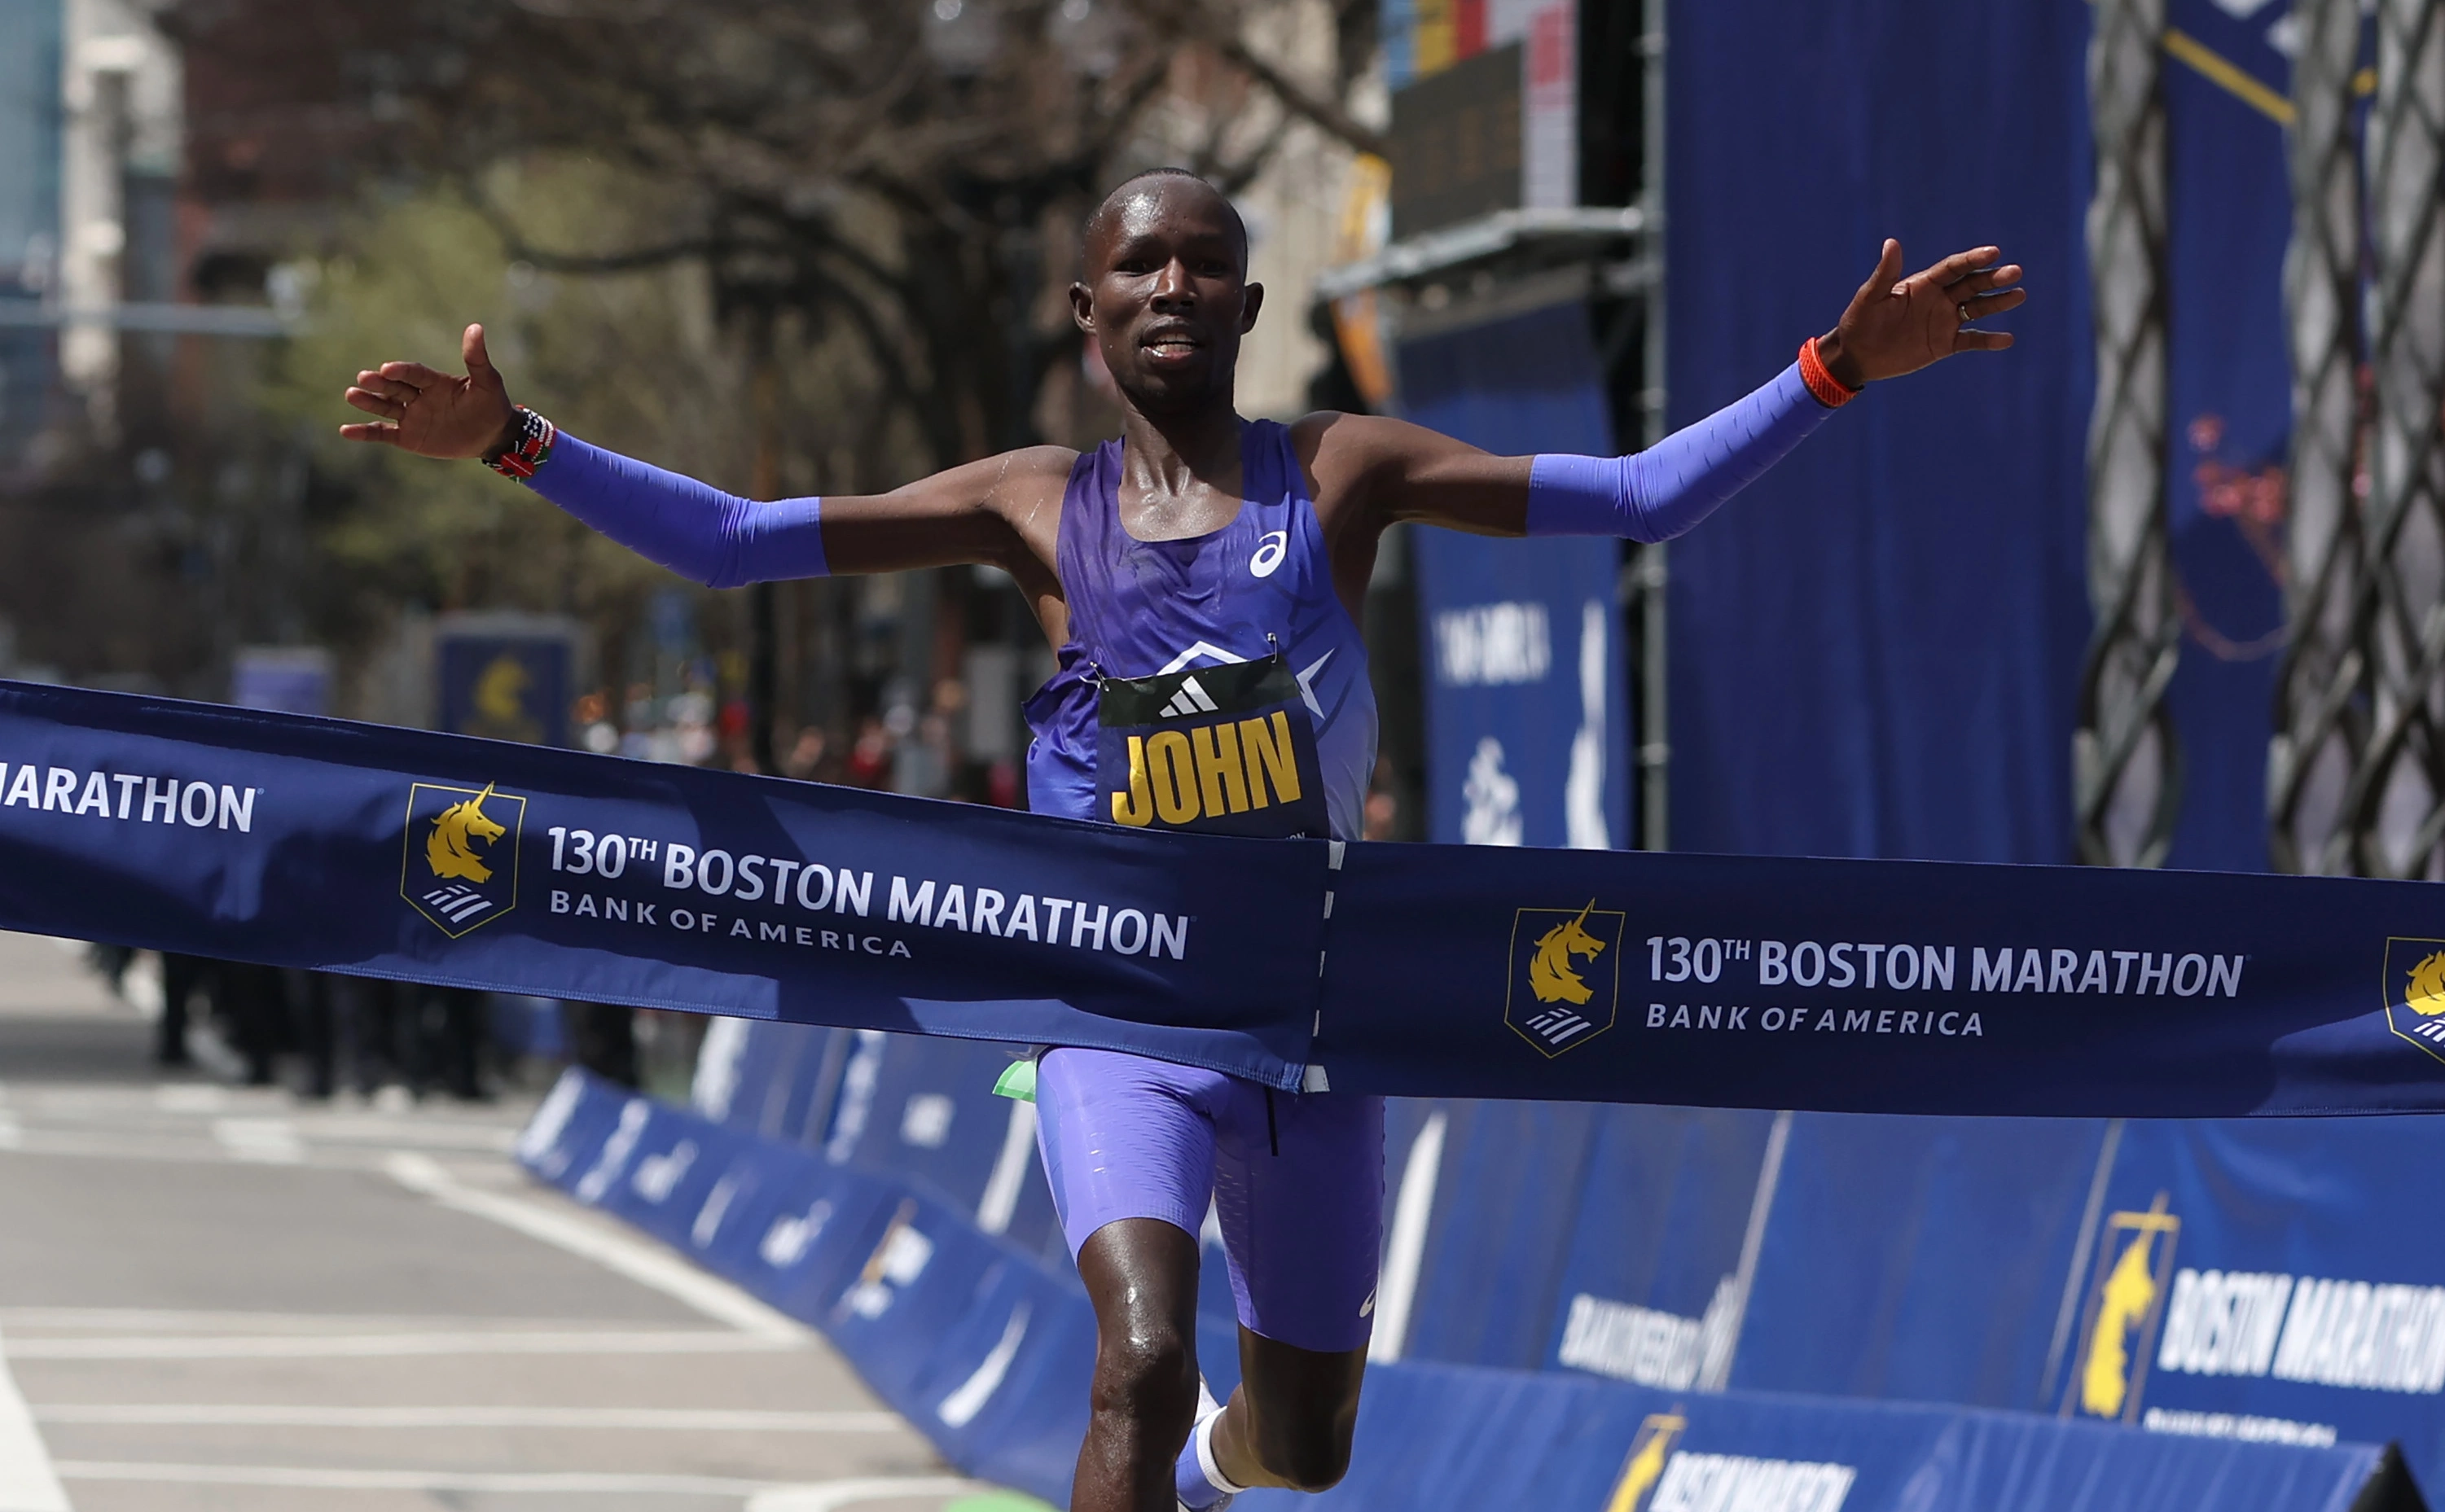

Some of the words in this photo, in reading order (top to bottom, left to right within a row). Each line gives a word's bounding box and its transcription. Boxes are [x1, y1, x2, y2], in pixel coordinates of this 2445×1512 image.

[1112, 710, 1302, 827] JOHN
[550, 889, 657, 927] BANK
[669, 909, 718, 933] OF
[729, 918, 912, 959] AMERICA
[663, 843, 874, 918] BOSTON
[887, 875, 1188, 961] MARATHON
[1759, 940, 1956, 991] BOSTON
[1969, 947, 2245, 998] MARATHON
[1645, 1003, 1750, 1031] BANK
[1760, 1007, 1809, 1032] OF
[1814, 1009, 1983, 1036] AMERICA
